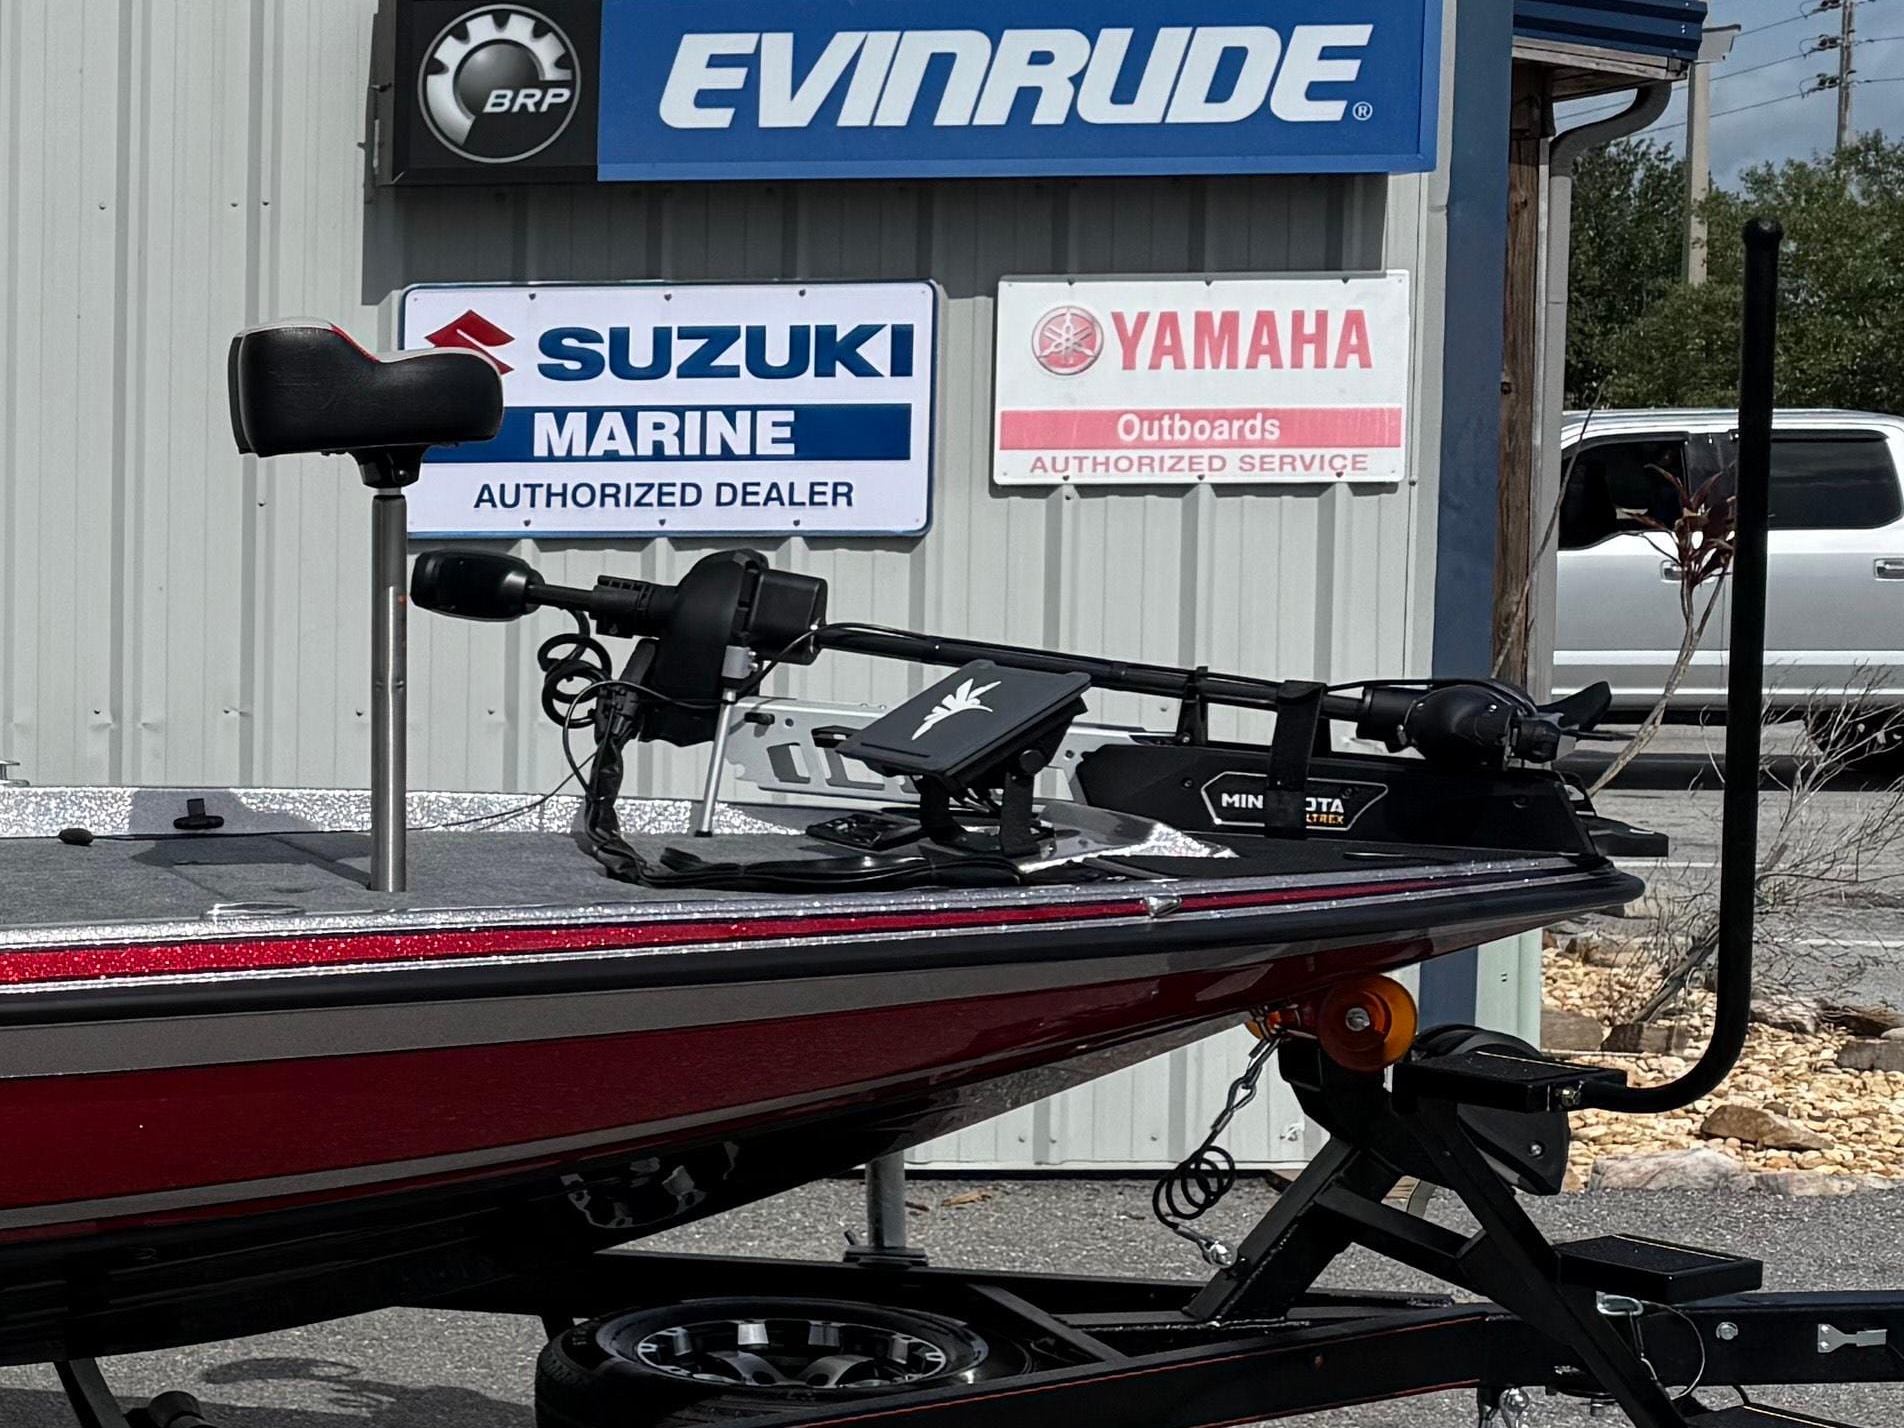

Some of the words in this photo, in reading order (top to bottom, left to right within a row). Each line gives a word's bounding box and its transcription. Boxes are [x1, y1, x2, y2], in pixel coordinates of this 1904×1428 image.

[482, 88, 572, 113] BRP
[537, 324, 914, 381] SUZUKI
[1111, 309, 1373, 371] YAMAHA
[533, 410, 795, 458] MARINE
[1117, 413, 1280, 442] Outboards
[1030, 454, 1227, 474] AUTHORIZED
[1239, 453, 1368, 472] SERVICE
[474, 482, 702, 509] AUTHORIZED
[715, 481, 854, 507] DEALER
[1221, 793, 1264, 810] MIN
[1305, 813, 1344, 824] LTREX
